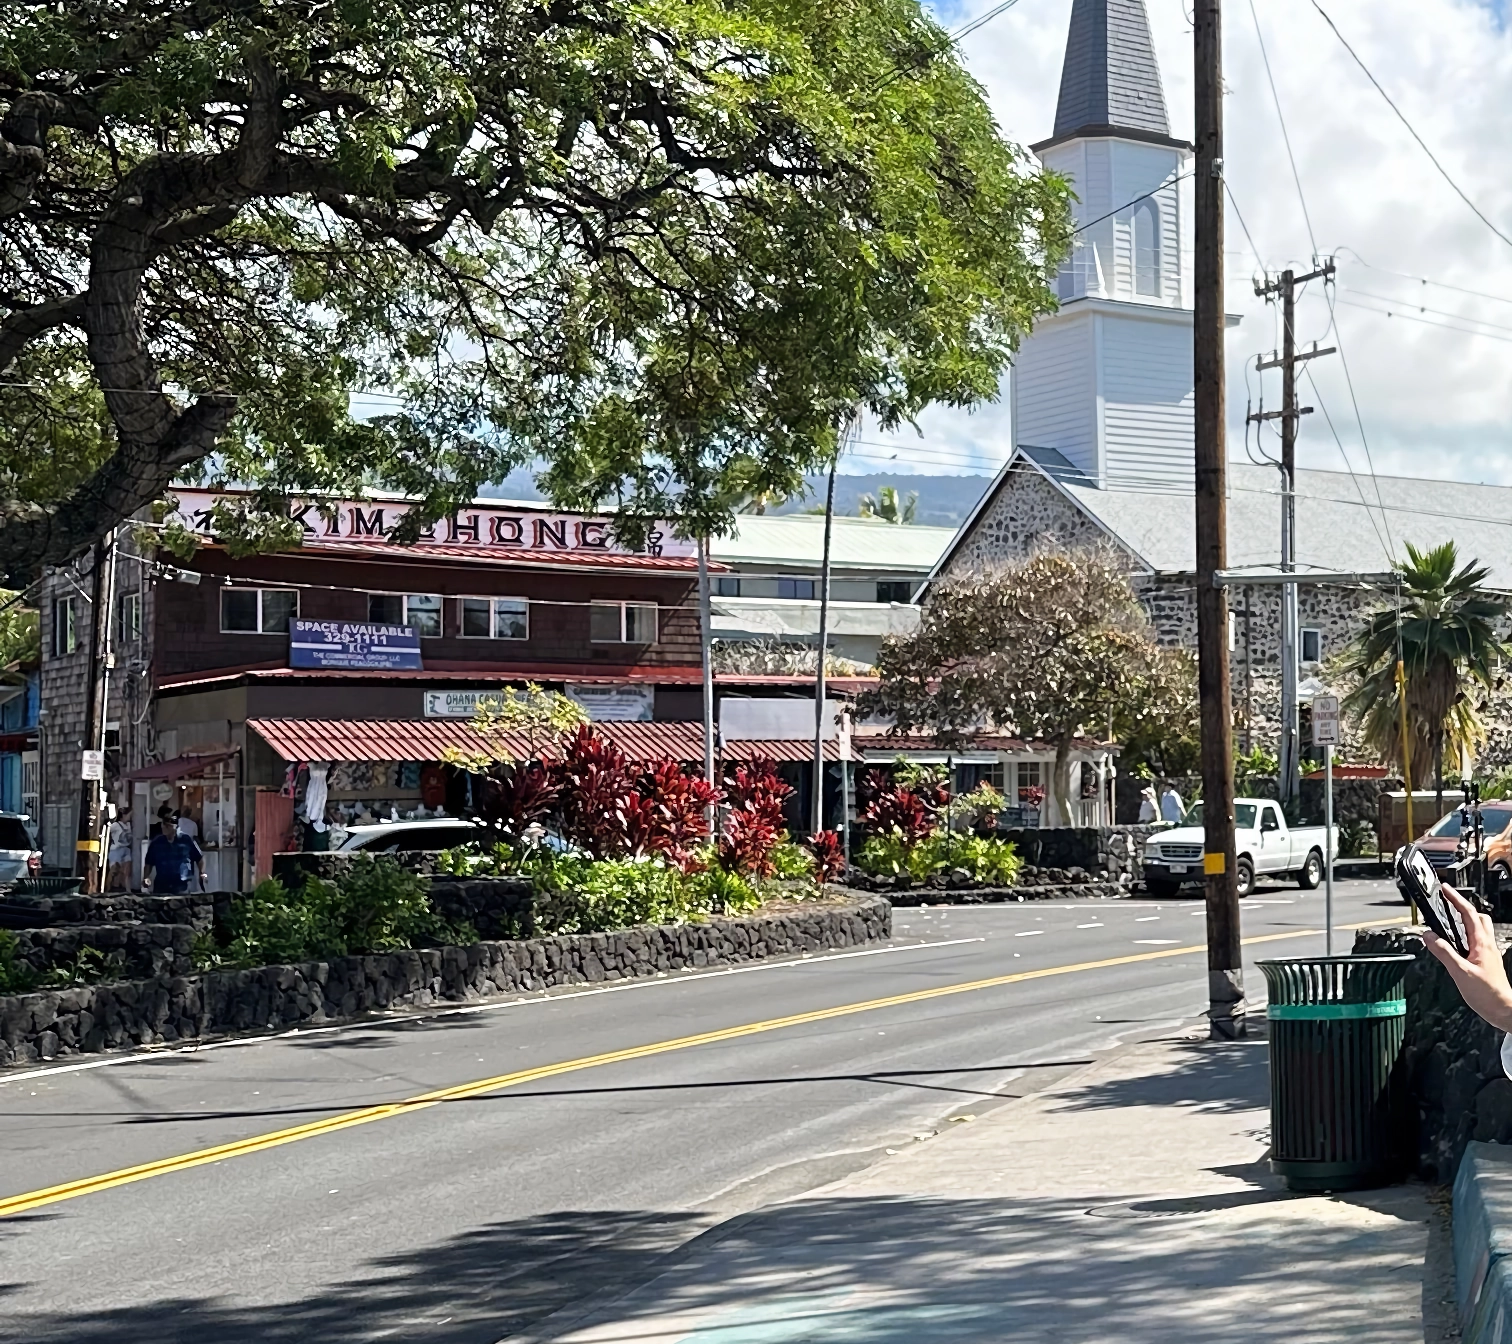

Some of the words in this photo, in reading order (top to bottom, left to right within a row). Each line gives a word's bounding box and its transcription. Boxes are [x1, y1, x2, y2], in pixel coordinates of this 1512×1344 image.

[296, 621, 338, 632] SPACE
[342, 624, 412, 637] AVAILABLE
[324, 632, 387, 645] 329-1111
[446, 693, 476, 705] OHANA
